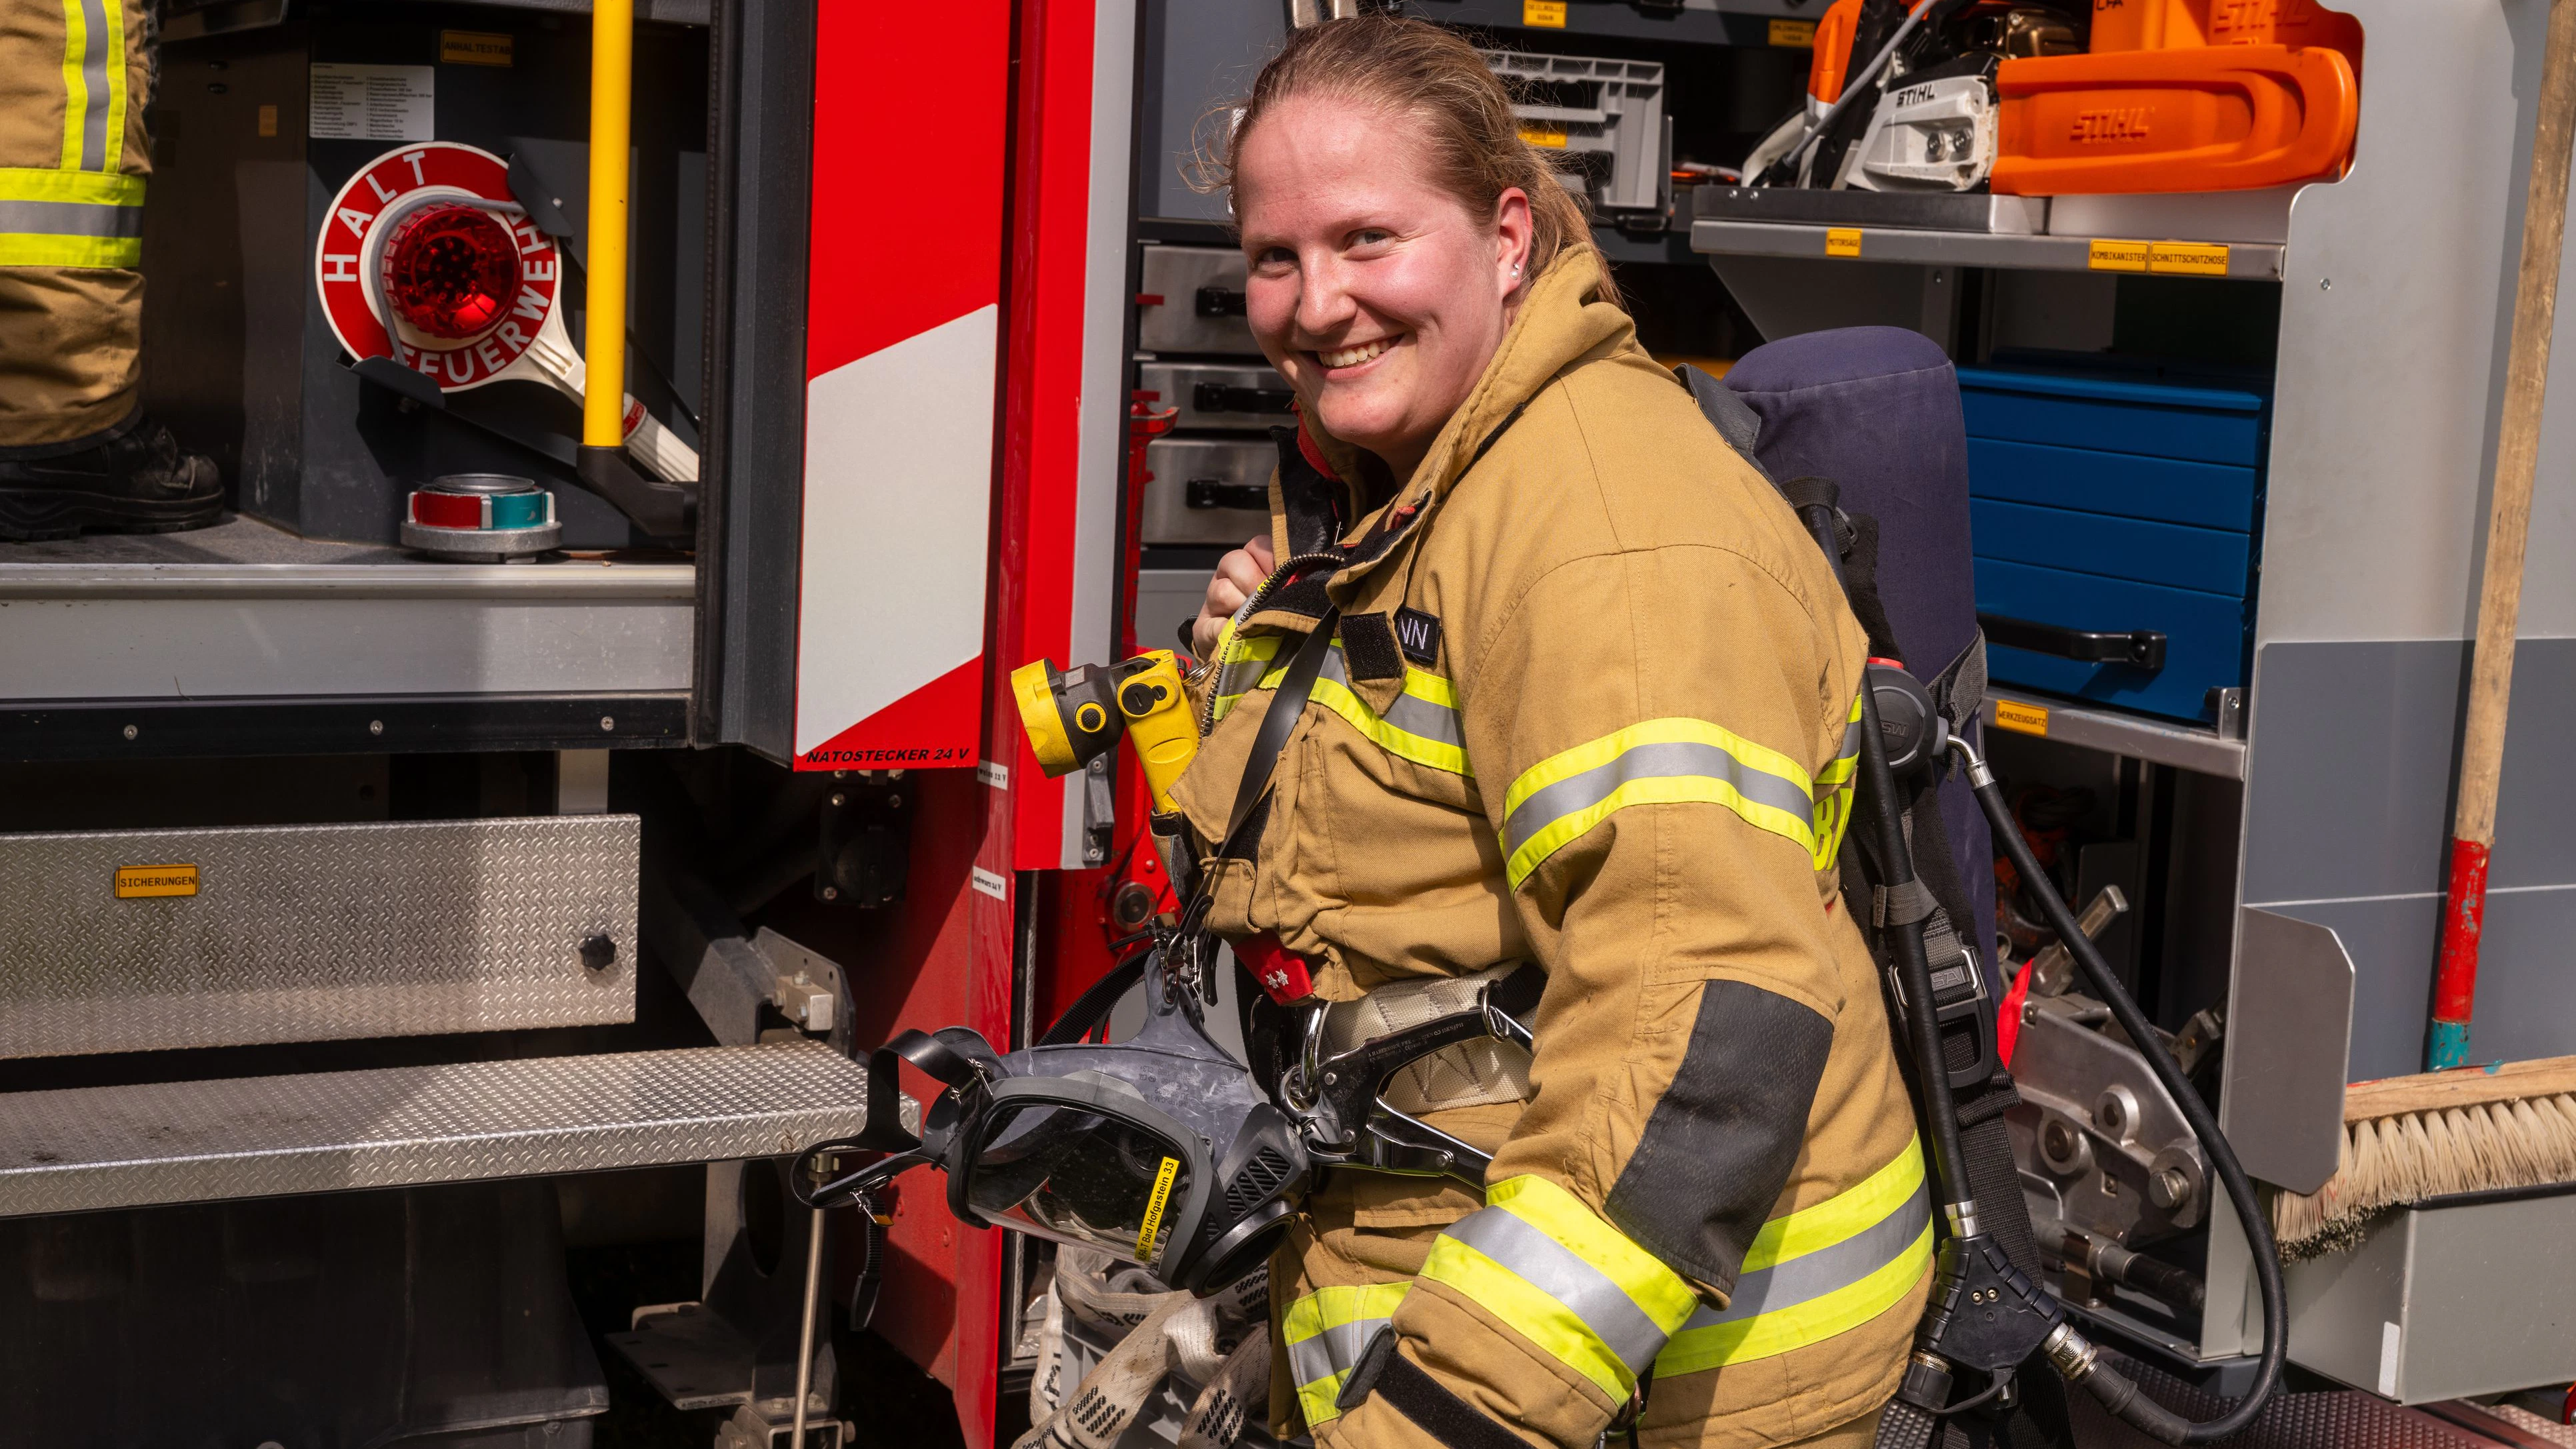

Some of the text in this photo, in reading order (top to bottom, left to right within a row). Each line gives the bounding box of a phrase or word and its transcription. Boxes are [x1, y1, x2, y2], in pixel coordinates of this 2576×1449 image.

[444, 41, 512, 55] ANHALTESTAB
[1896, 84, 1935, 108] STIHL
[2069, 108, 2148, 141] STIHL
[323, 151, 426, 283] HALT
[2092, 250, 2147, 262] KOMBIKANISTER
[2152, 252, 2227, 265] SCHNITTSCHUTZHOSE
[1999, 710, 2046, 728] WERKZEUGSATZ
[1880, 721, 1907, 736] MS
[806, 748, 970, 763] NATOSTECKER 24 V
[120, 876, 195, 888] SICHERUNGEN
[1931, 971, 1961, 988] SA
[1163, 1161, 1174, 1174] 33
[1147, 1177, 1170, 1227] Hofgastein
[1142, 1229, 1153, 1241] Bad
